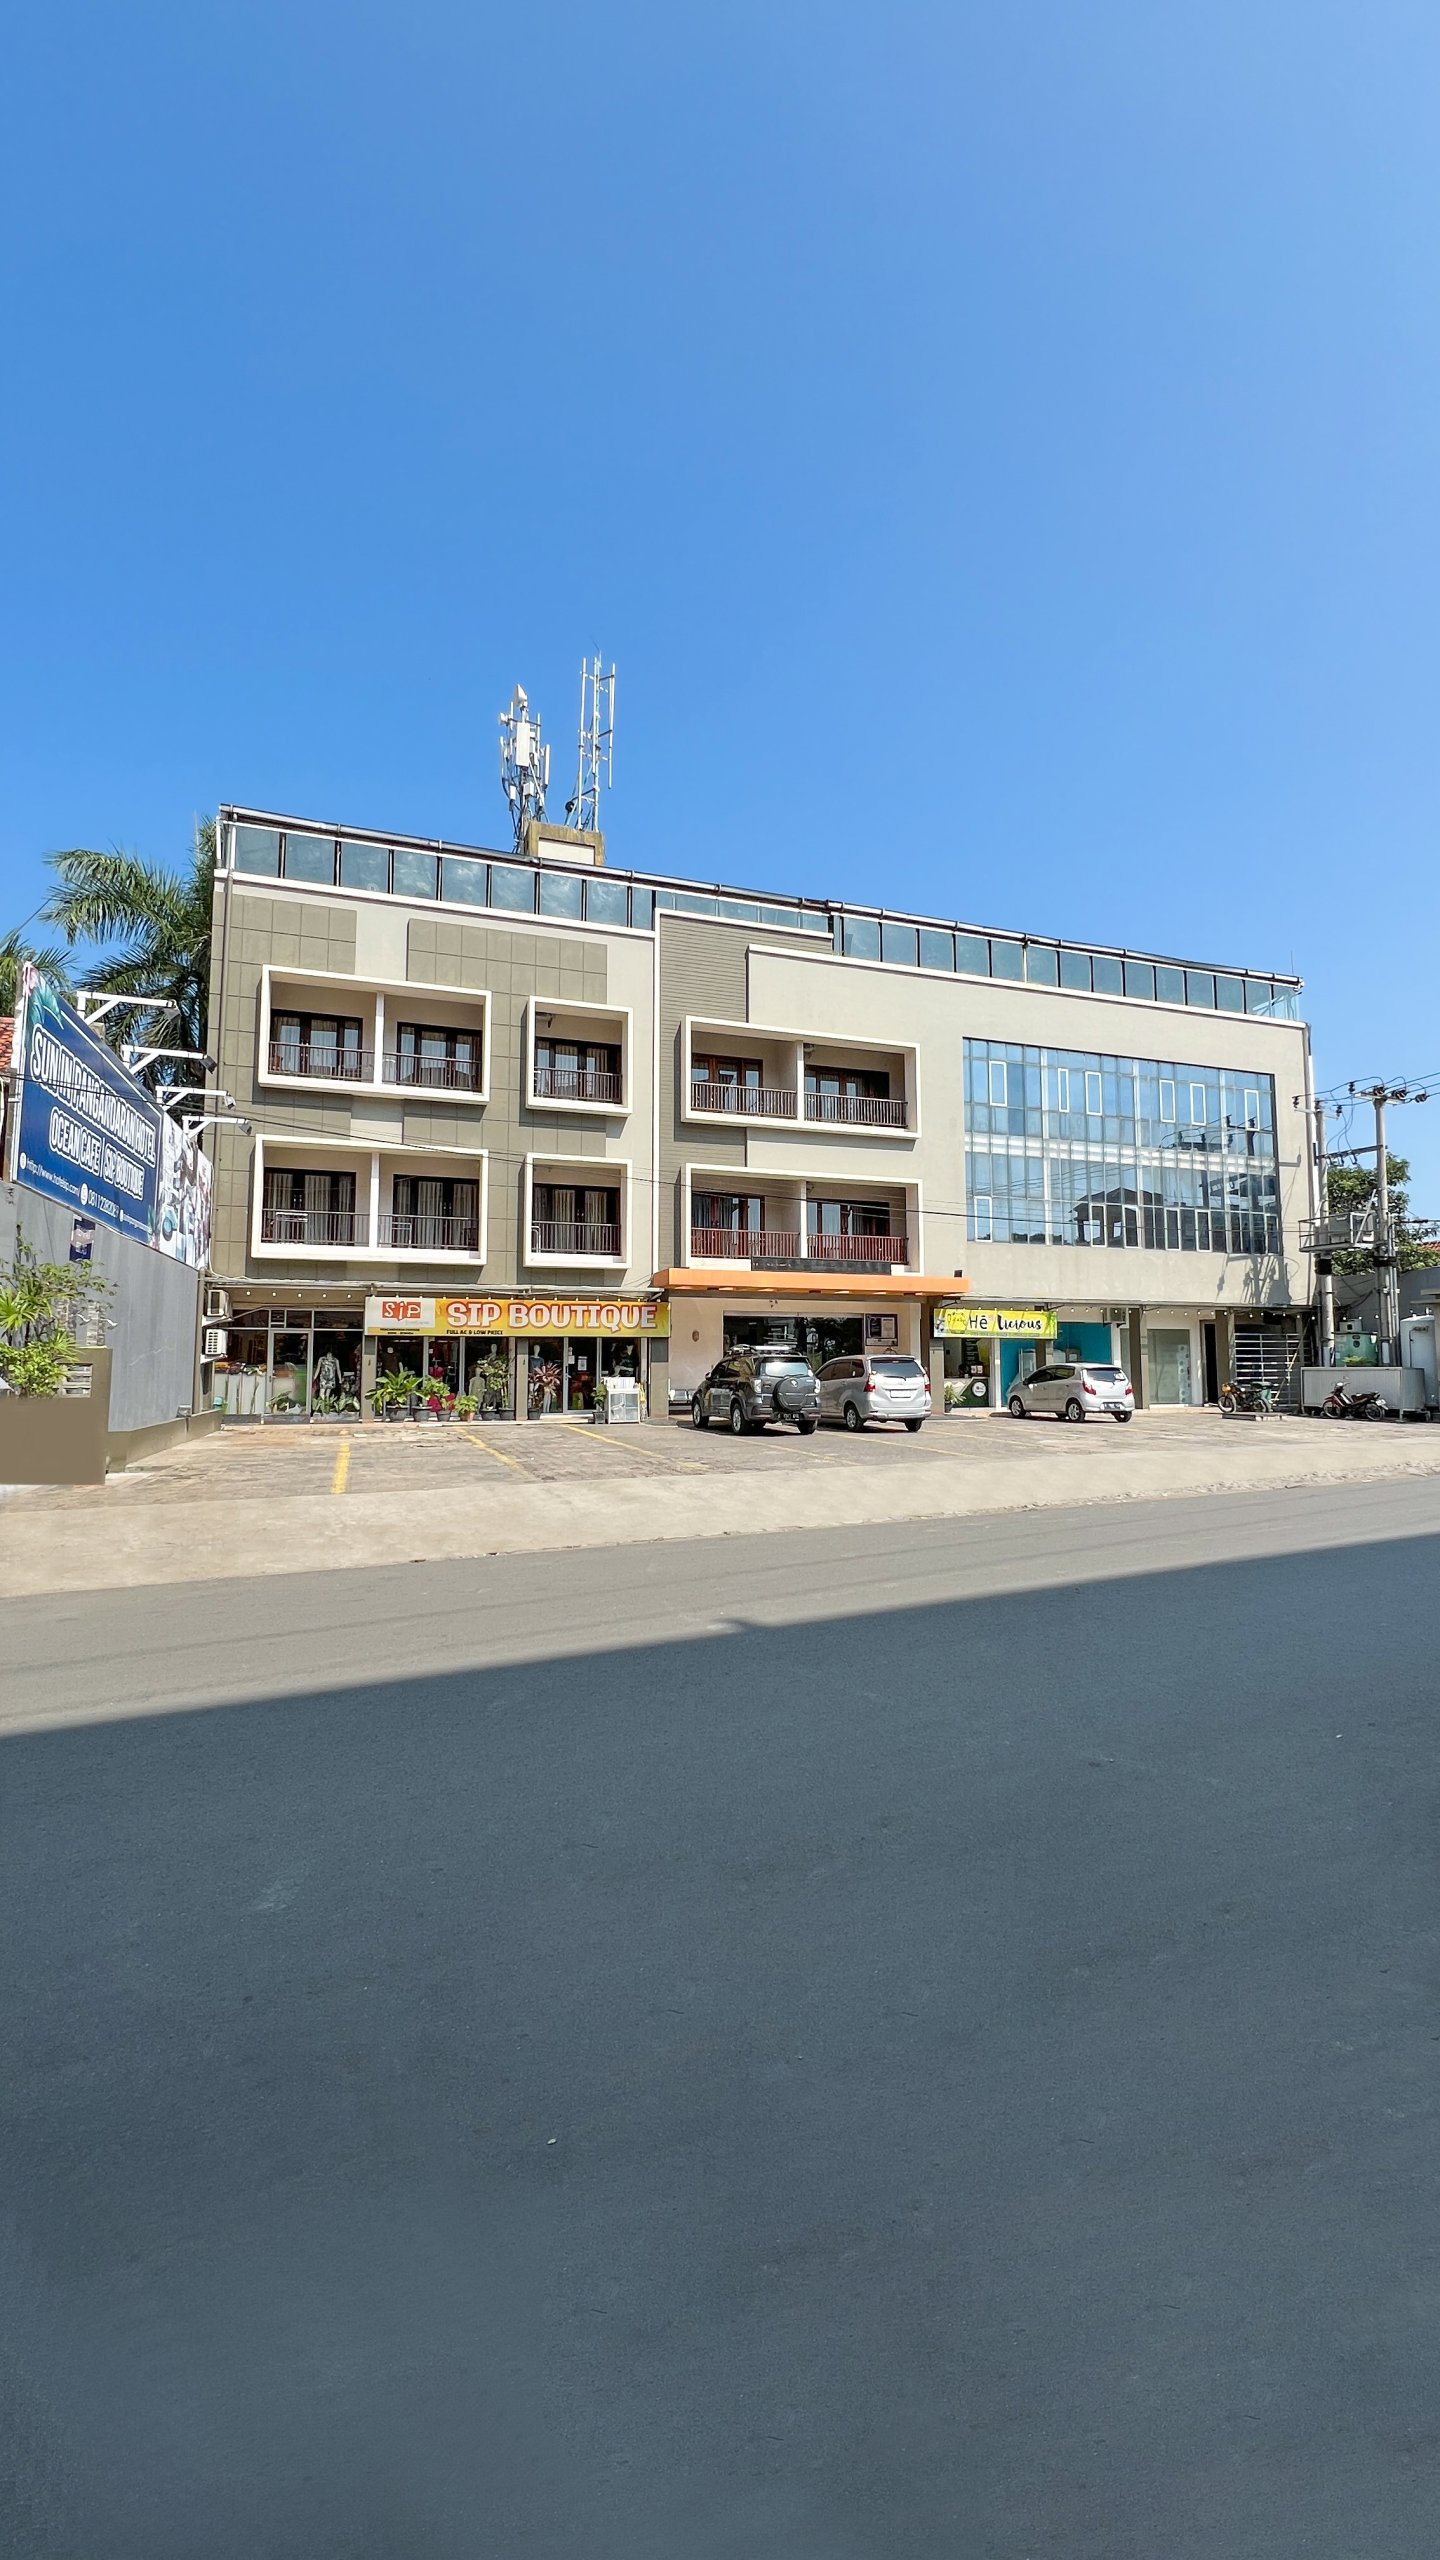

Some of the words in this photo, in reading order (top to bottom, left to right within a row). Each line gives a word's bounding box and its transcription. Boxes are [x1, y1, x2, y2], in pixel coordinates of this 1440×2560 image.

[32, 1029, 60, 1095] SUN
[60, 1050, 74, 1105] IN
[74, 1060, 137, 1150] PANGANDARAN
[137, 1119, 155, 1167] HOTEL
[51, 1110, 80, 1163] OCEAN
[80, 1130, 102, 1177] CAFE
[447, 1302, 502, 1328] SIP
[508, 1303, 658, 1333] BOUTIQUE
